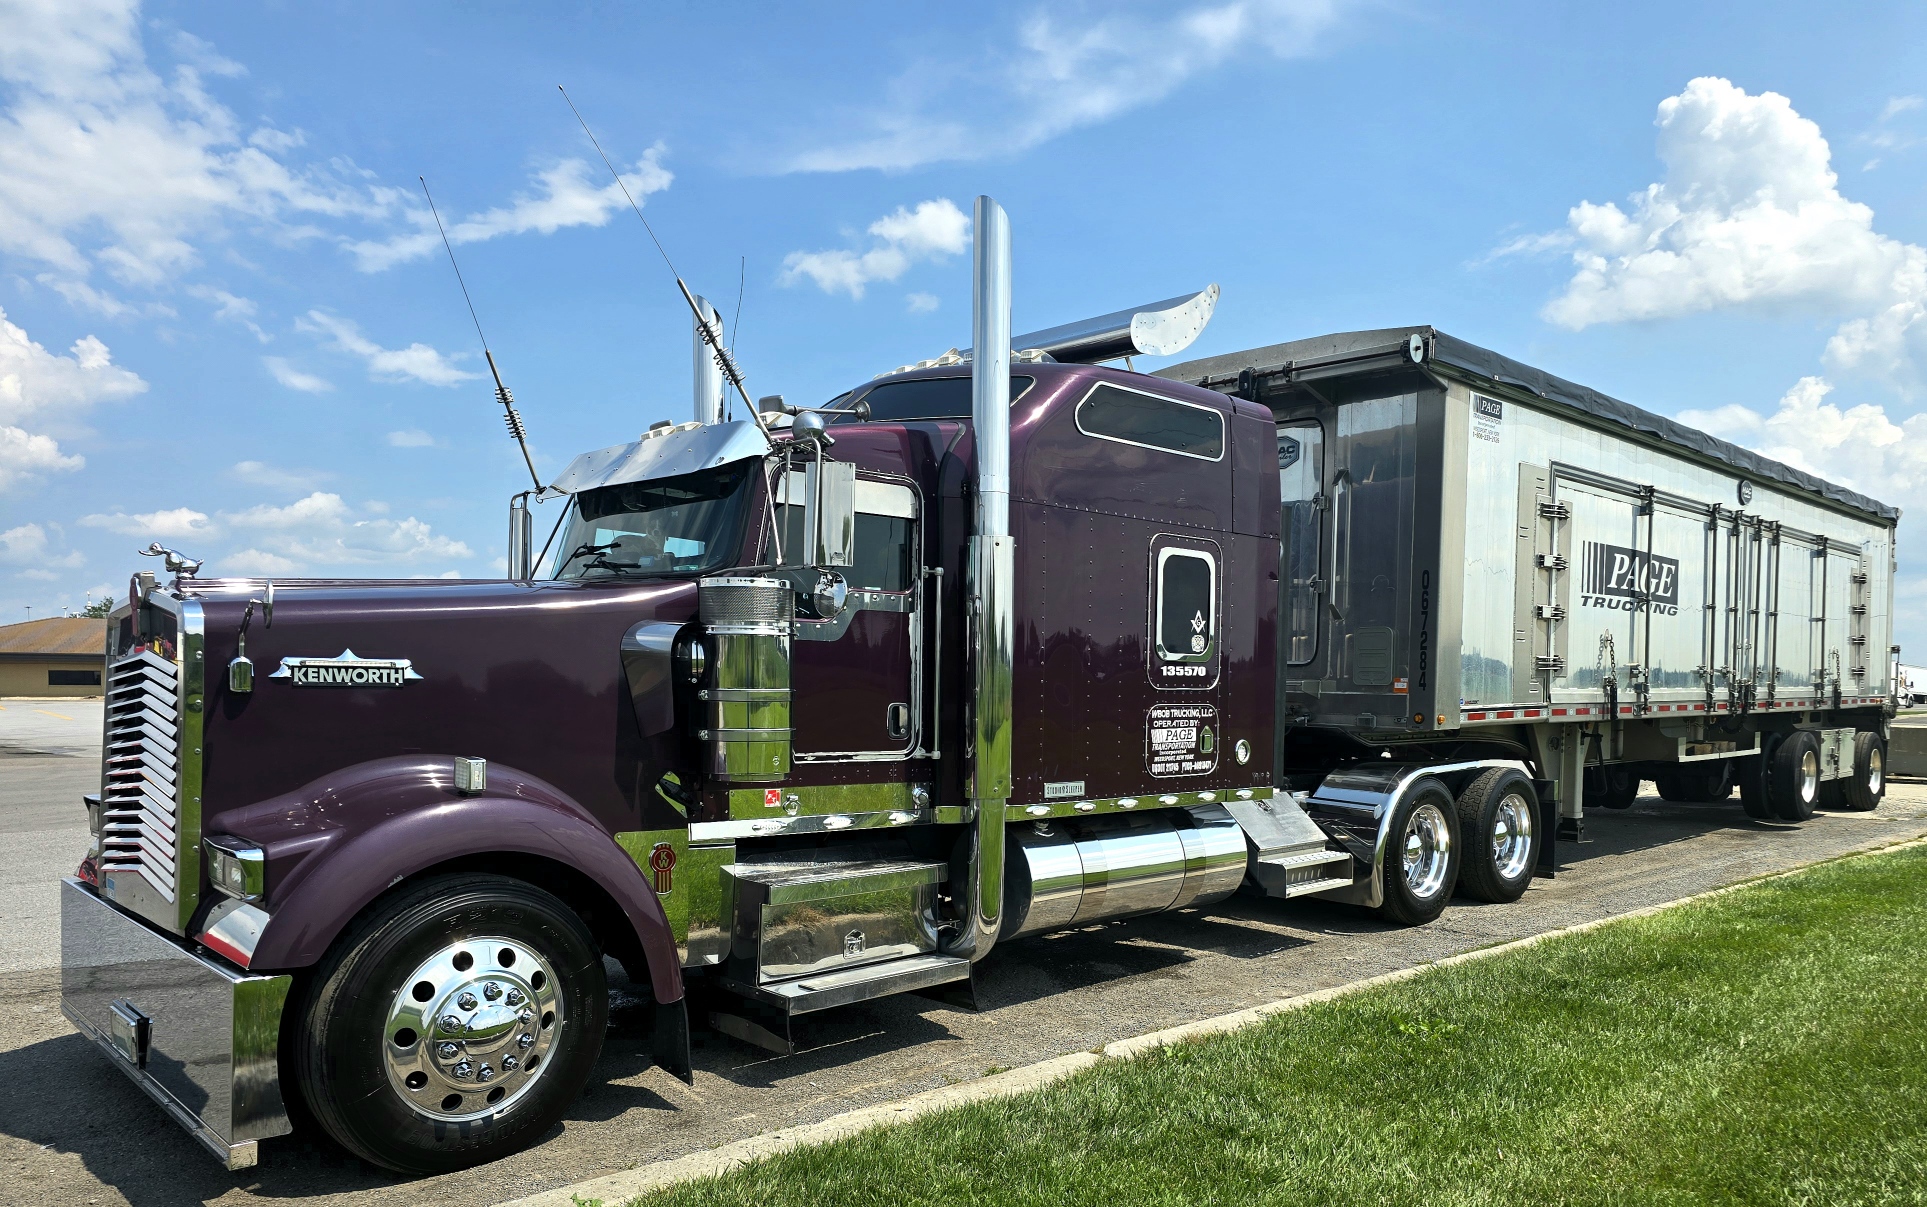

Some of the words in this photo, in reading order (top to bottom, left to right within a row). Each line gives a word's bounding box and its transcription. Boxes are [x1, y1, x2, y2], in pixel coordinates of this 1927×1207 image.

[1481, 400, 1500, 415] PAGE
[1278, 445, 1296, 454] AC
[1606, 553, 1676, 597] PAGE
[1418, 569, 1430, 691] 067284
[293, 667, 404, 684] KENWORTH
[1160, 665, 1207, 677] 135570
[1201, 708, 1214, 717] LLC
[1153, 720, 1189, 728] OPERATED
[1165, 729, 1194, 741] PAGE
